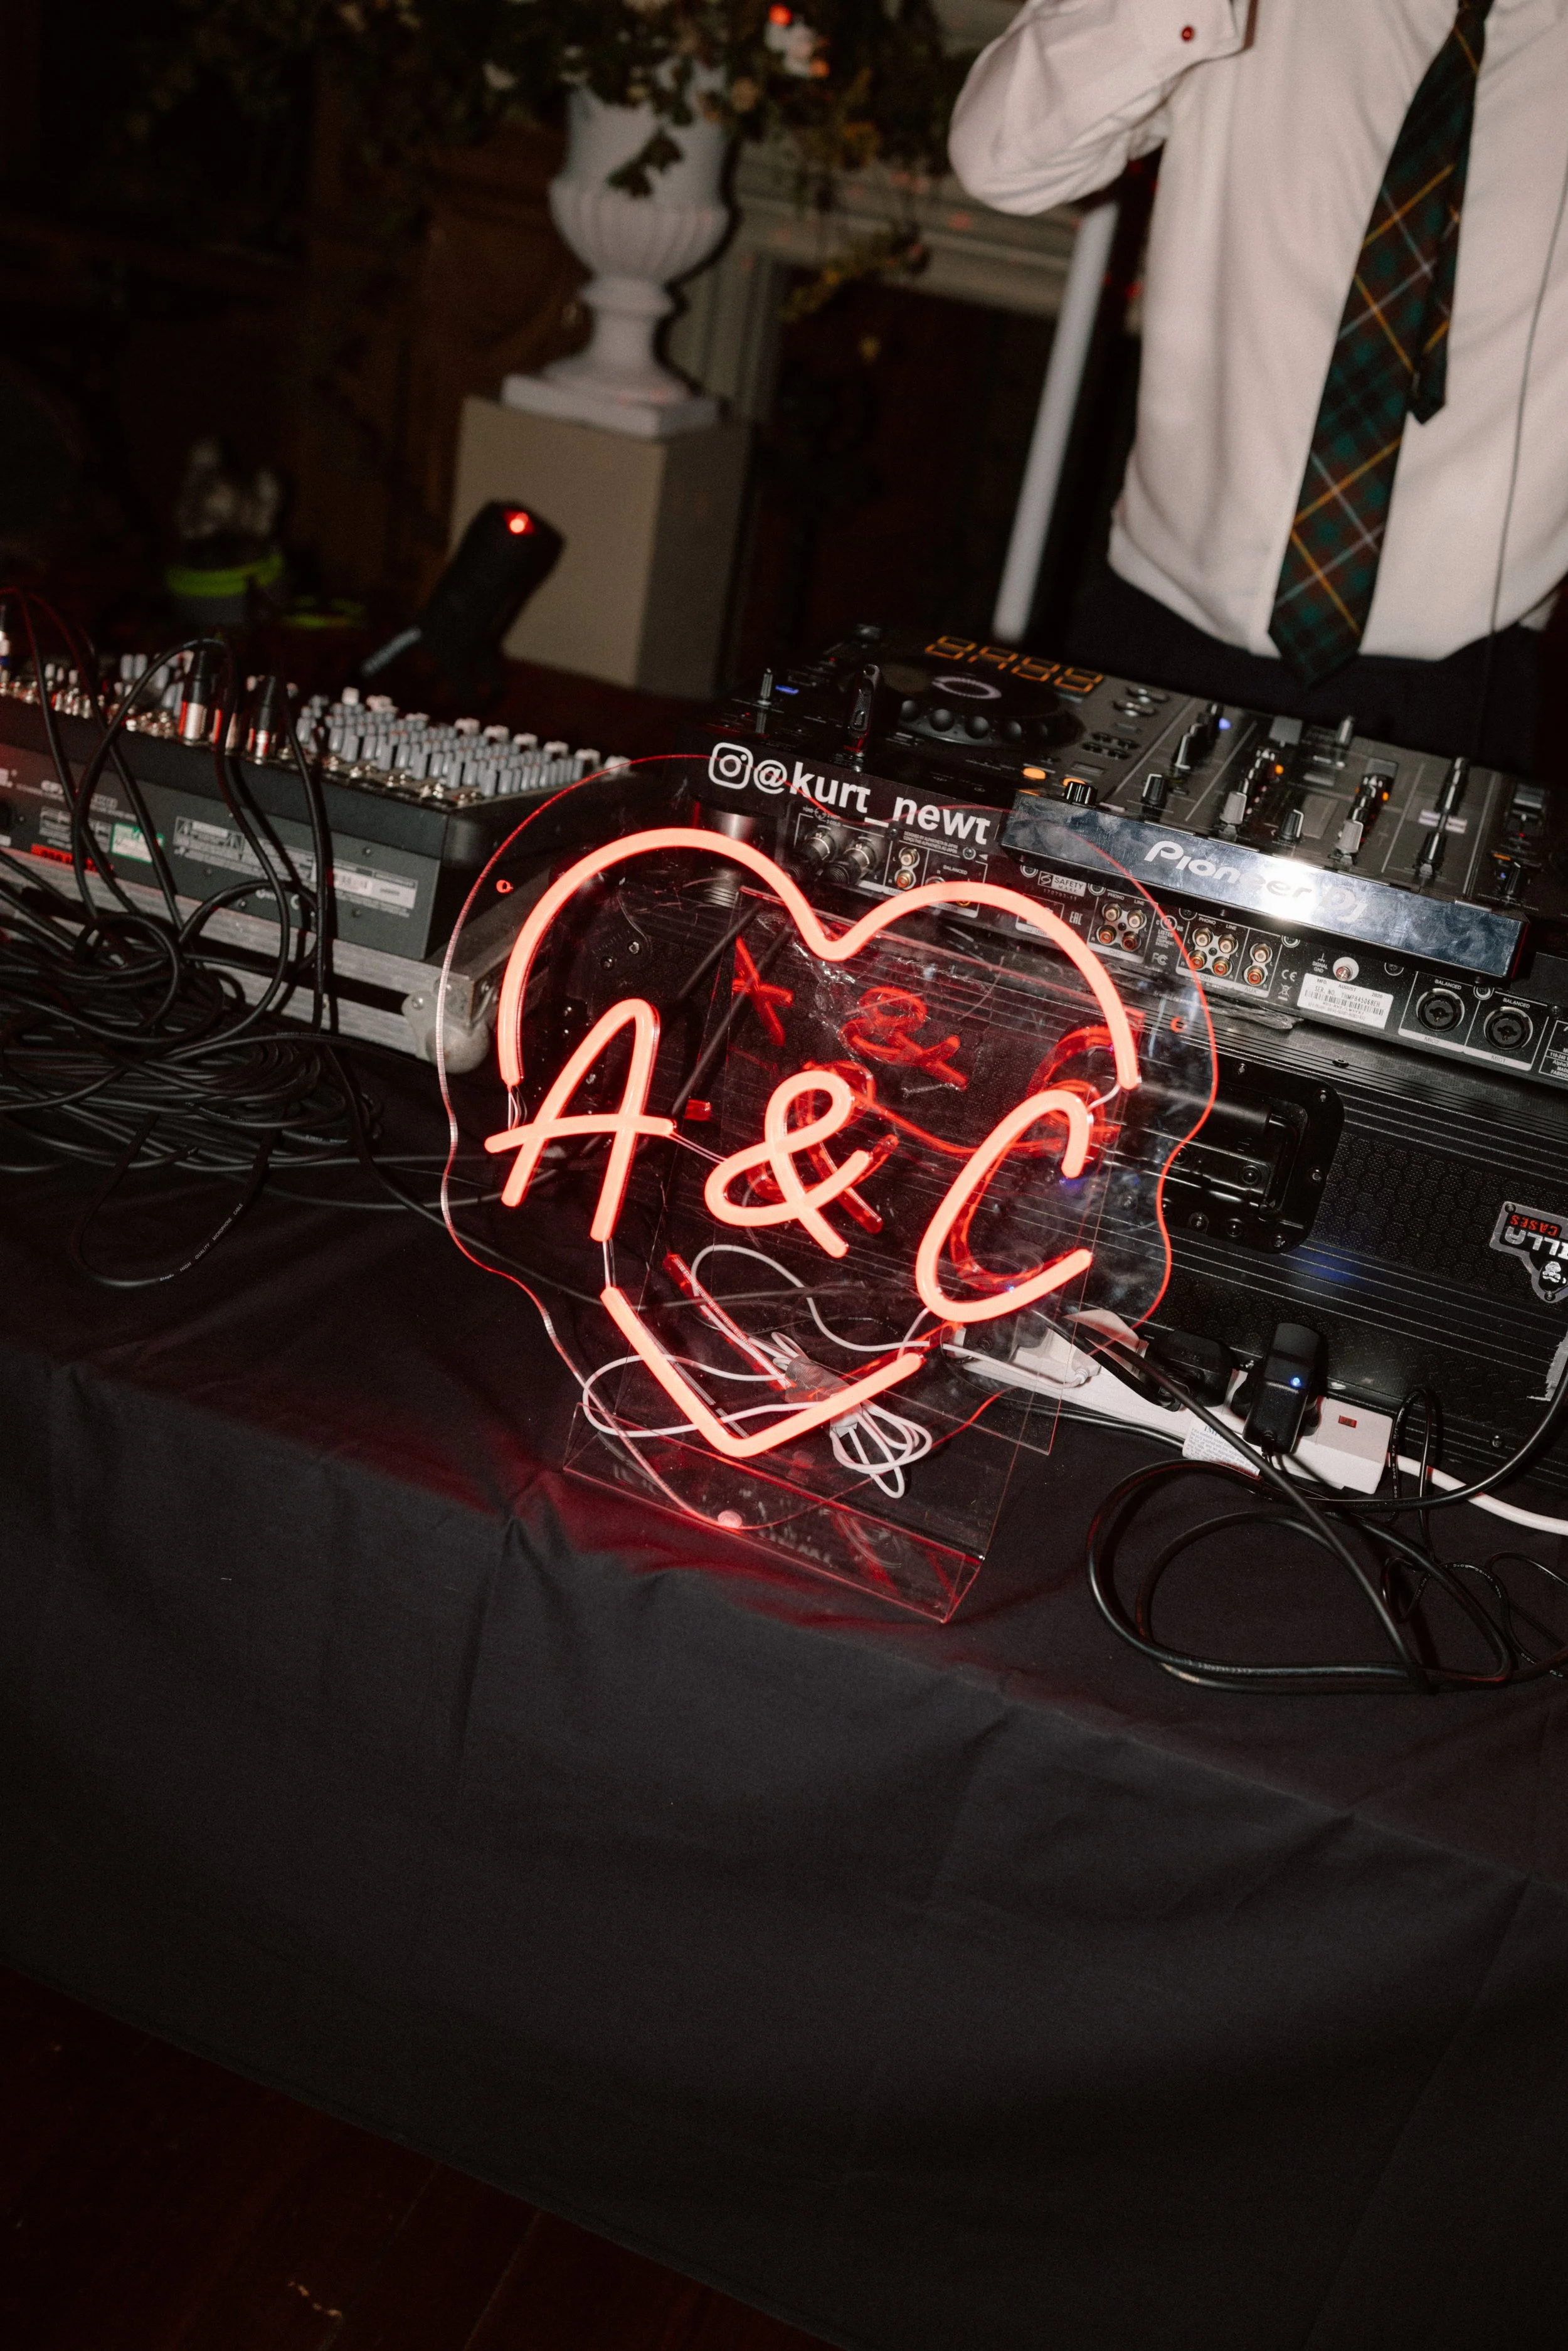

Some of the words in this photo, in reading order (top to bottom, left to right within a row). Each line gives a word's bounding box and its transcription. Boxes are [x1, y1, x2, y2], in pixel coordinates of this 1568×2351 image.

[753, 760, 991, 845] @kurt_newt
[943, 864, 968, 875] BALANCED
[1054, 877, 1084, 889] SAFETY
[1144, 841, 1312, 898] Pioneer
[1320, 886, 1368, 922] DJ
[1108, 892, 1125, 901] PHONO
[1199, 916, 1216, 925] PHONO
[1158, 930, 1173, 938] LISTED
[1312, 961, 1328, 969] SIGNAL
[1315, 985, 1325, 994] SER.
[1434, 979, 1461, 990] BALANCED
[1503, 997, 1530, 1009] BALANCED
[1491, 1054, 1506, 1063] MIC1
[484, 999, 676, 1241] A
[704, 1069, 872, 1258] &
[916, 1088, 1093, 1322] C
[1510, 1214, 1559, 1237] CASES
